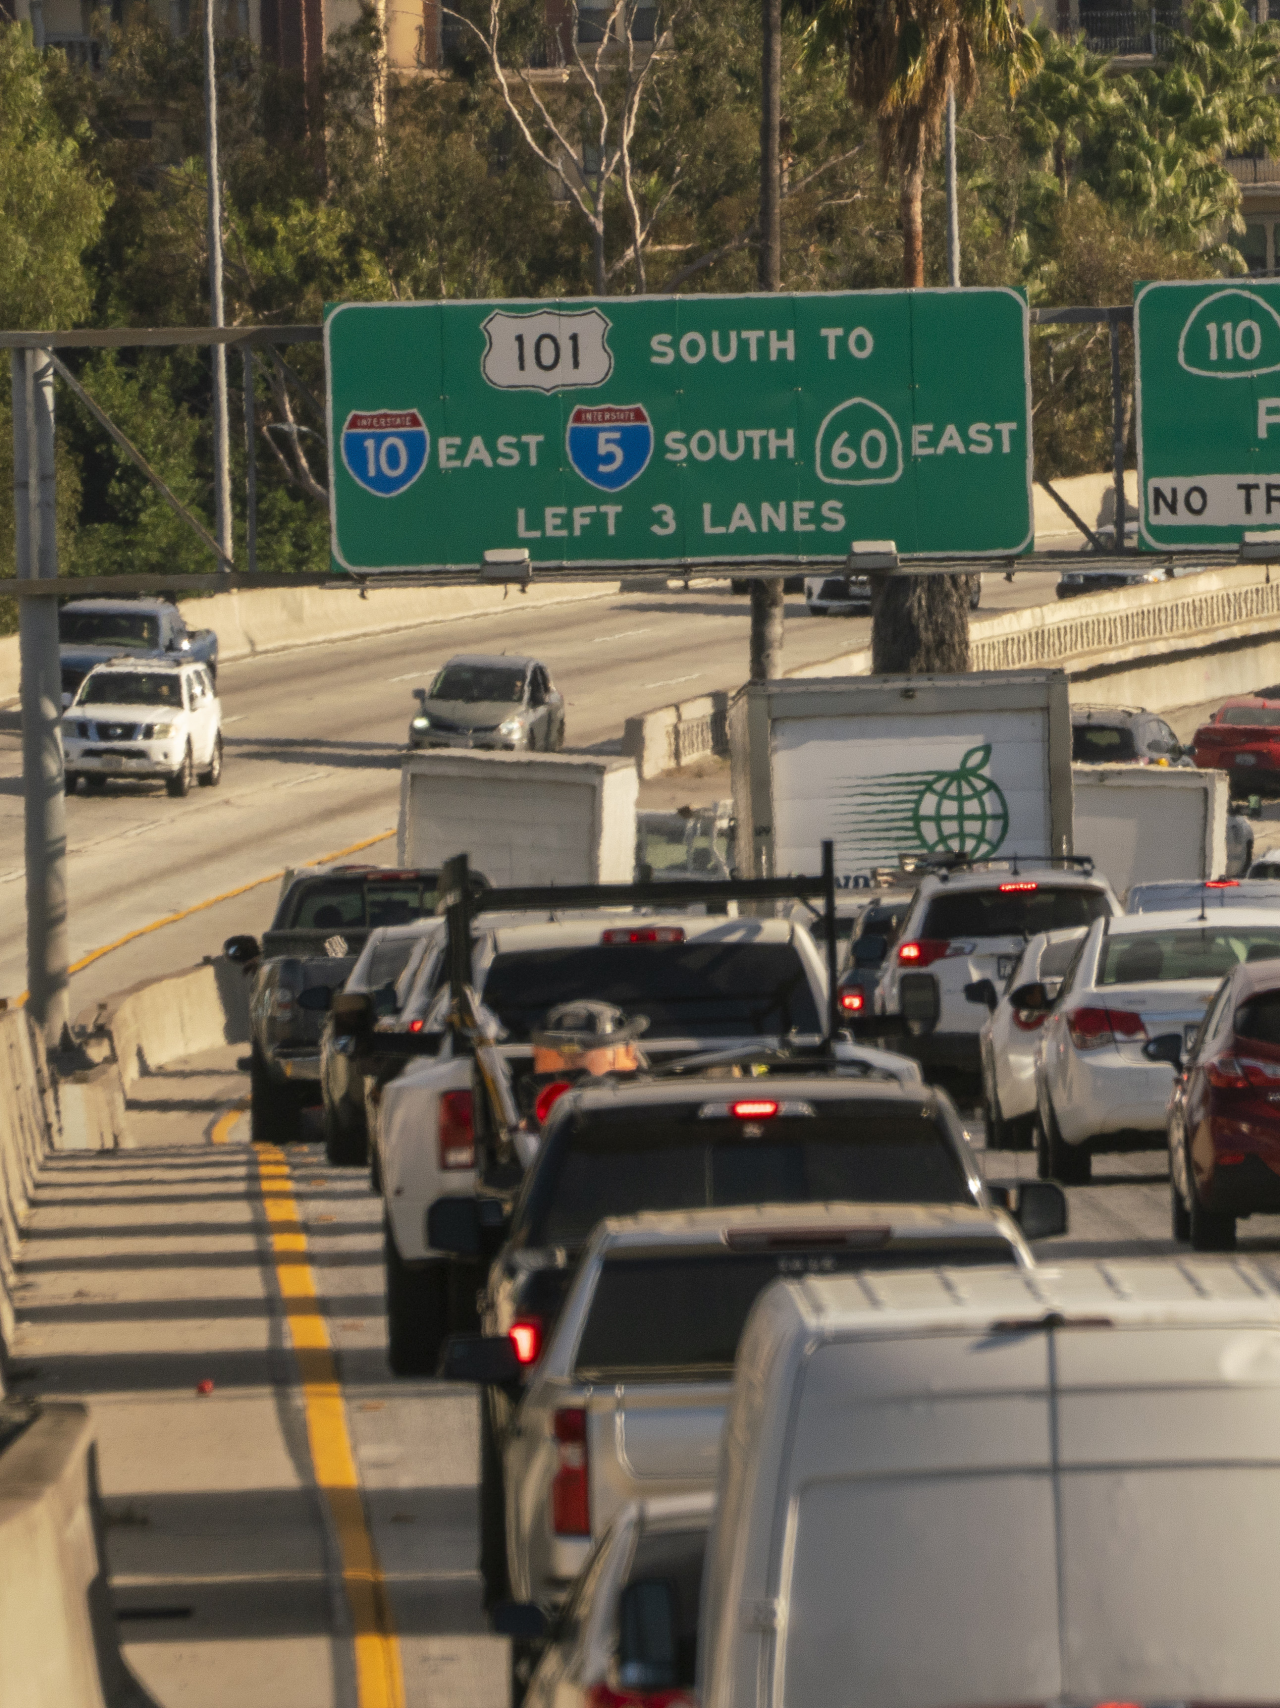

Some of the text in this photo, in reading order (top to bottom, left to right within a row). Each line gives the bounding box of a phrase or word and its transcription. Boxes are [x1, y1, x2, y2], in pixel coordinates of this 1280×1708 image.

[515, 333, 579, 371] 101
[651, 327, 874, 364] SOUTH TO
[1206, 319, 1261, 360] 110
[357, 416, 412, 427] INTERSTATE
[582, 411, 635, 421] INTERSTATE
[364, 436, 408, 477] 10
[438, 435, 544, 468] EAST
[598, 431, 623, 472] 5
[664, 428, 794, 461] SOUTH
[831, 429, 887, 469] 60
[912, 422, 1017, 455] EAST
[517, 500, 845, 538] LEFT 3 LANES
[1154, 486, 1207, 515] NO
